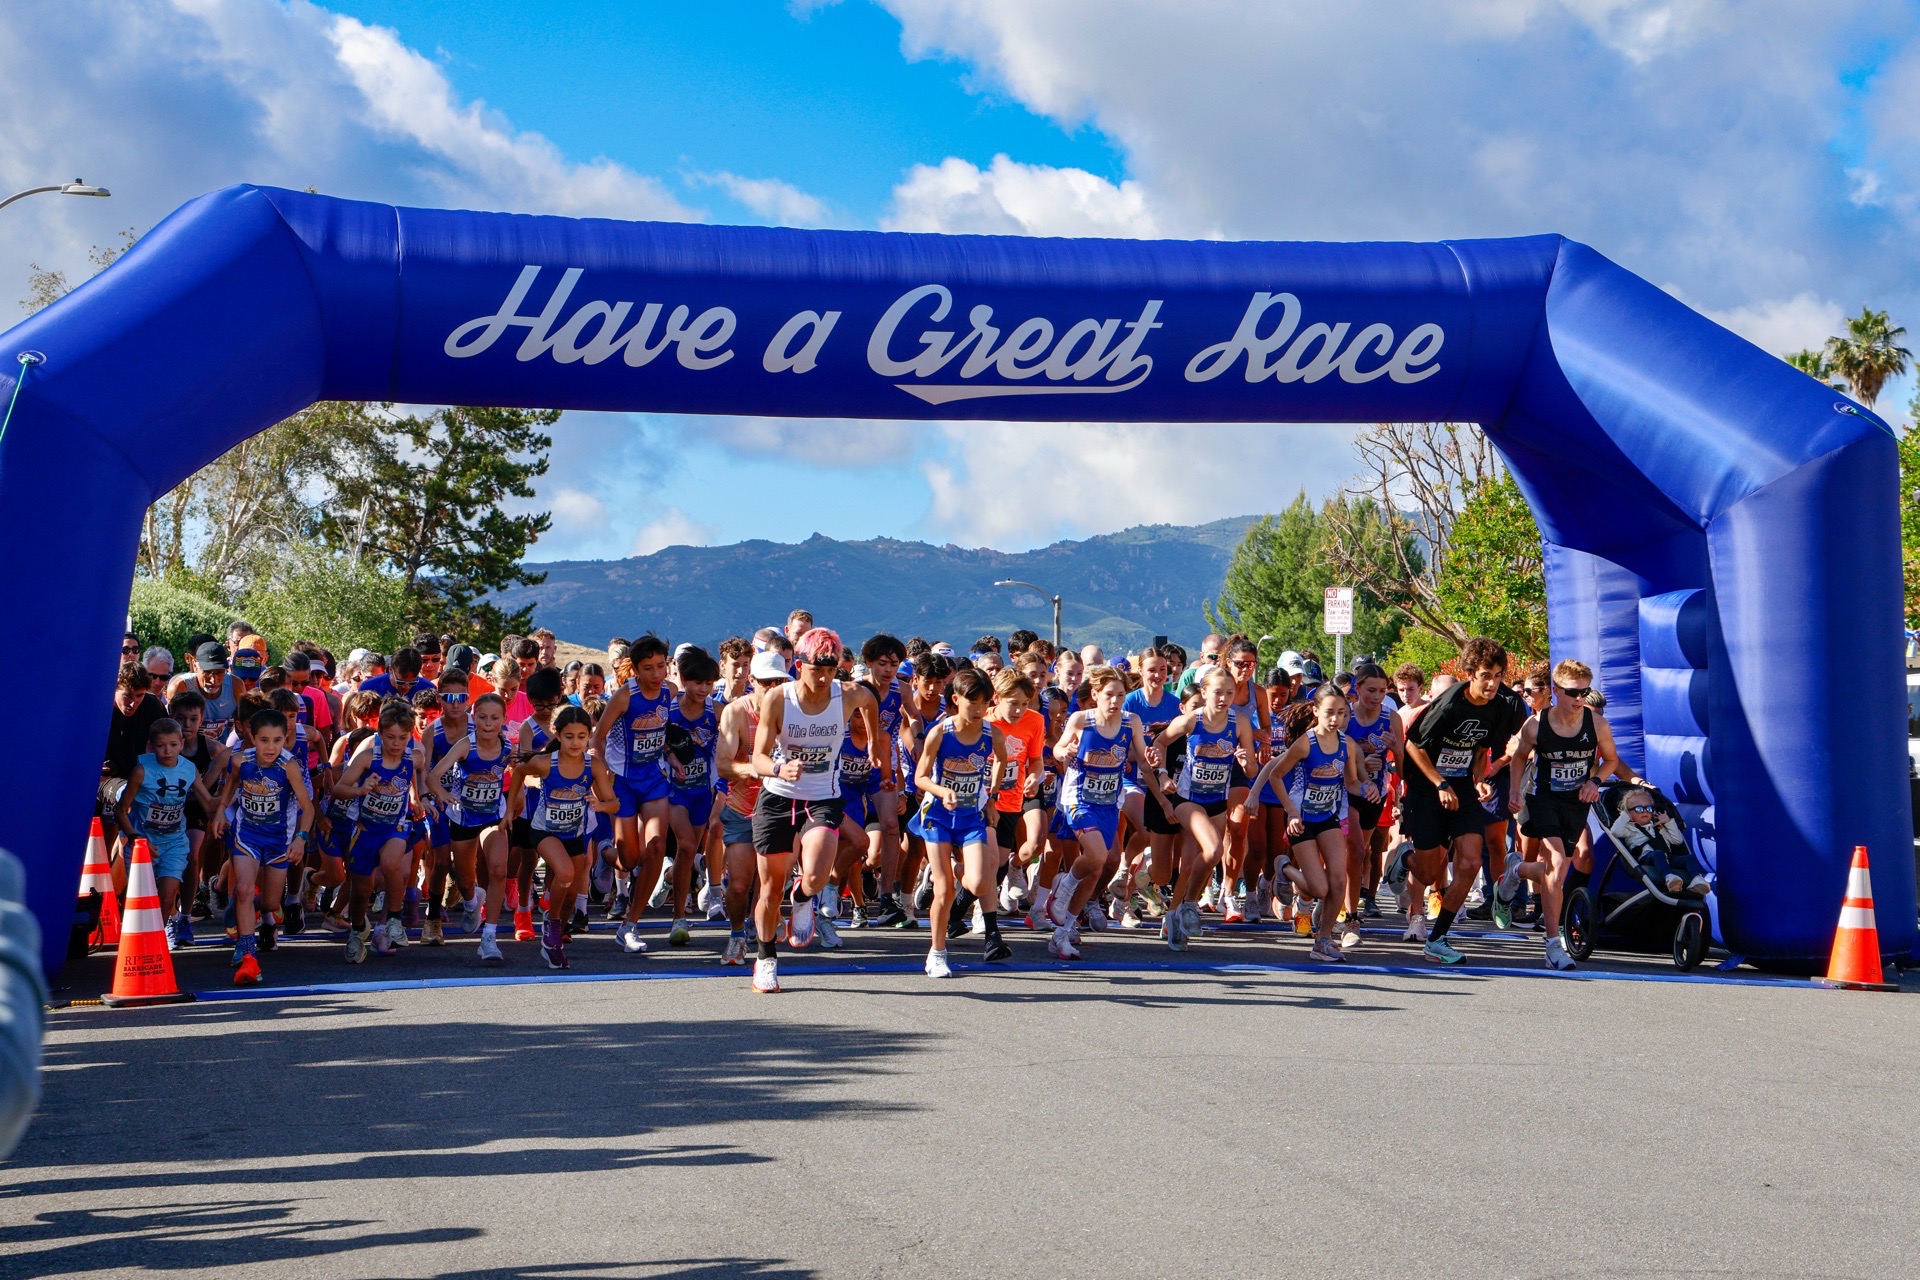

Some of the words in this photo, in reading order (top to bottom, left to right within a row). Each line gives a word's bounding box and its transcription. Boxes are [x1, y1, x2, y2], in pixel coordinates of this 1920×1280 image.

[445, 265, 736, 370] Have
[763, 311, 841, 373] a
[867, 285, 1163, 405] Great
[1185, 292, 1444, 383] Race
[1328, 590, 1336, 598] NO
[1328, 600, 1350, 608] PARKING
[788, 724, 807, 738] The
[809, 724, 838, 737] Coast
[637, 737, 663, 750] 5045
[791, 752, 826, 762] 5022
[1566, 749, 1594, 758] PARK
[1441, 755, 1468, 765] 5994
[684, 764, 704, 776] 026
[843, 761, 871, 772] 5044
[1196, 767, 1224, 780] 5505
[1555, 768, 1583, 778] 5105
[944, 780, 976, 793] 5040
[1088, 779, 1115, 791] 5106
[466, 788, 497, 799] 5113
[245, 799, 275, 812] 5012
[368, 797, 399, 812] 5409
[151, 809, 180, 821] 5763
[550, 808, 581, 821] 5059
[125, 956, 141, 965] RP
